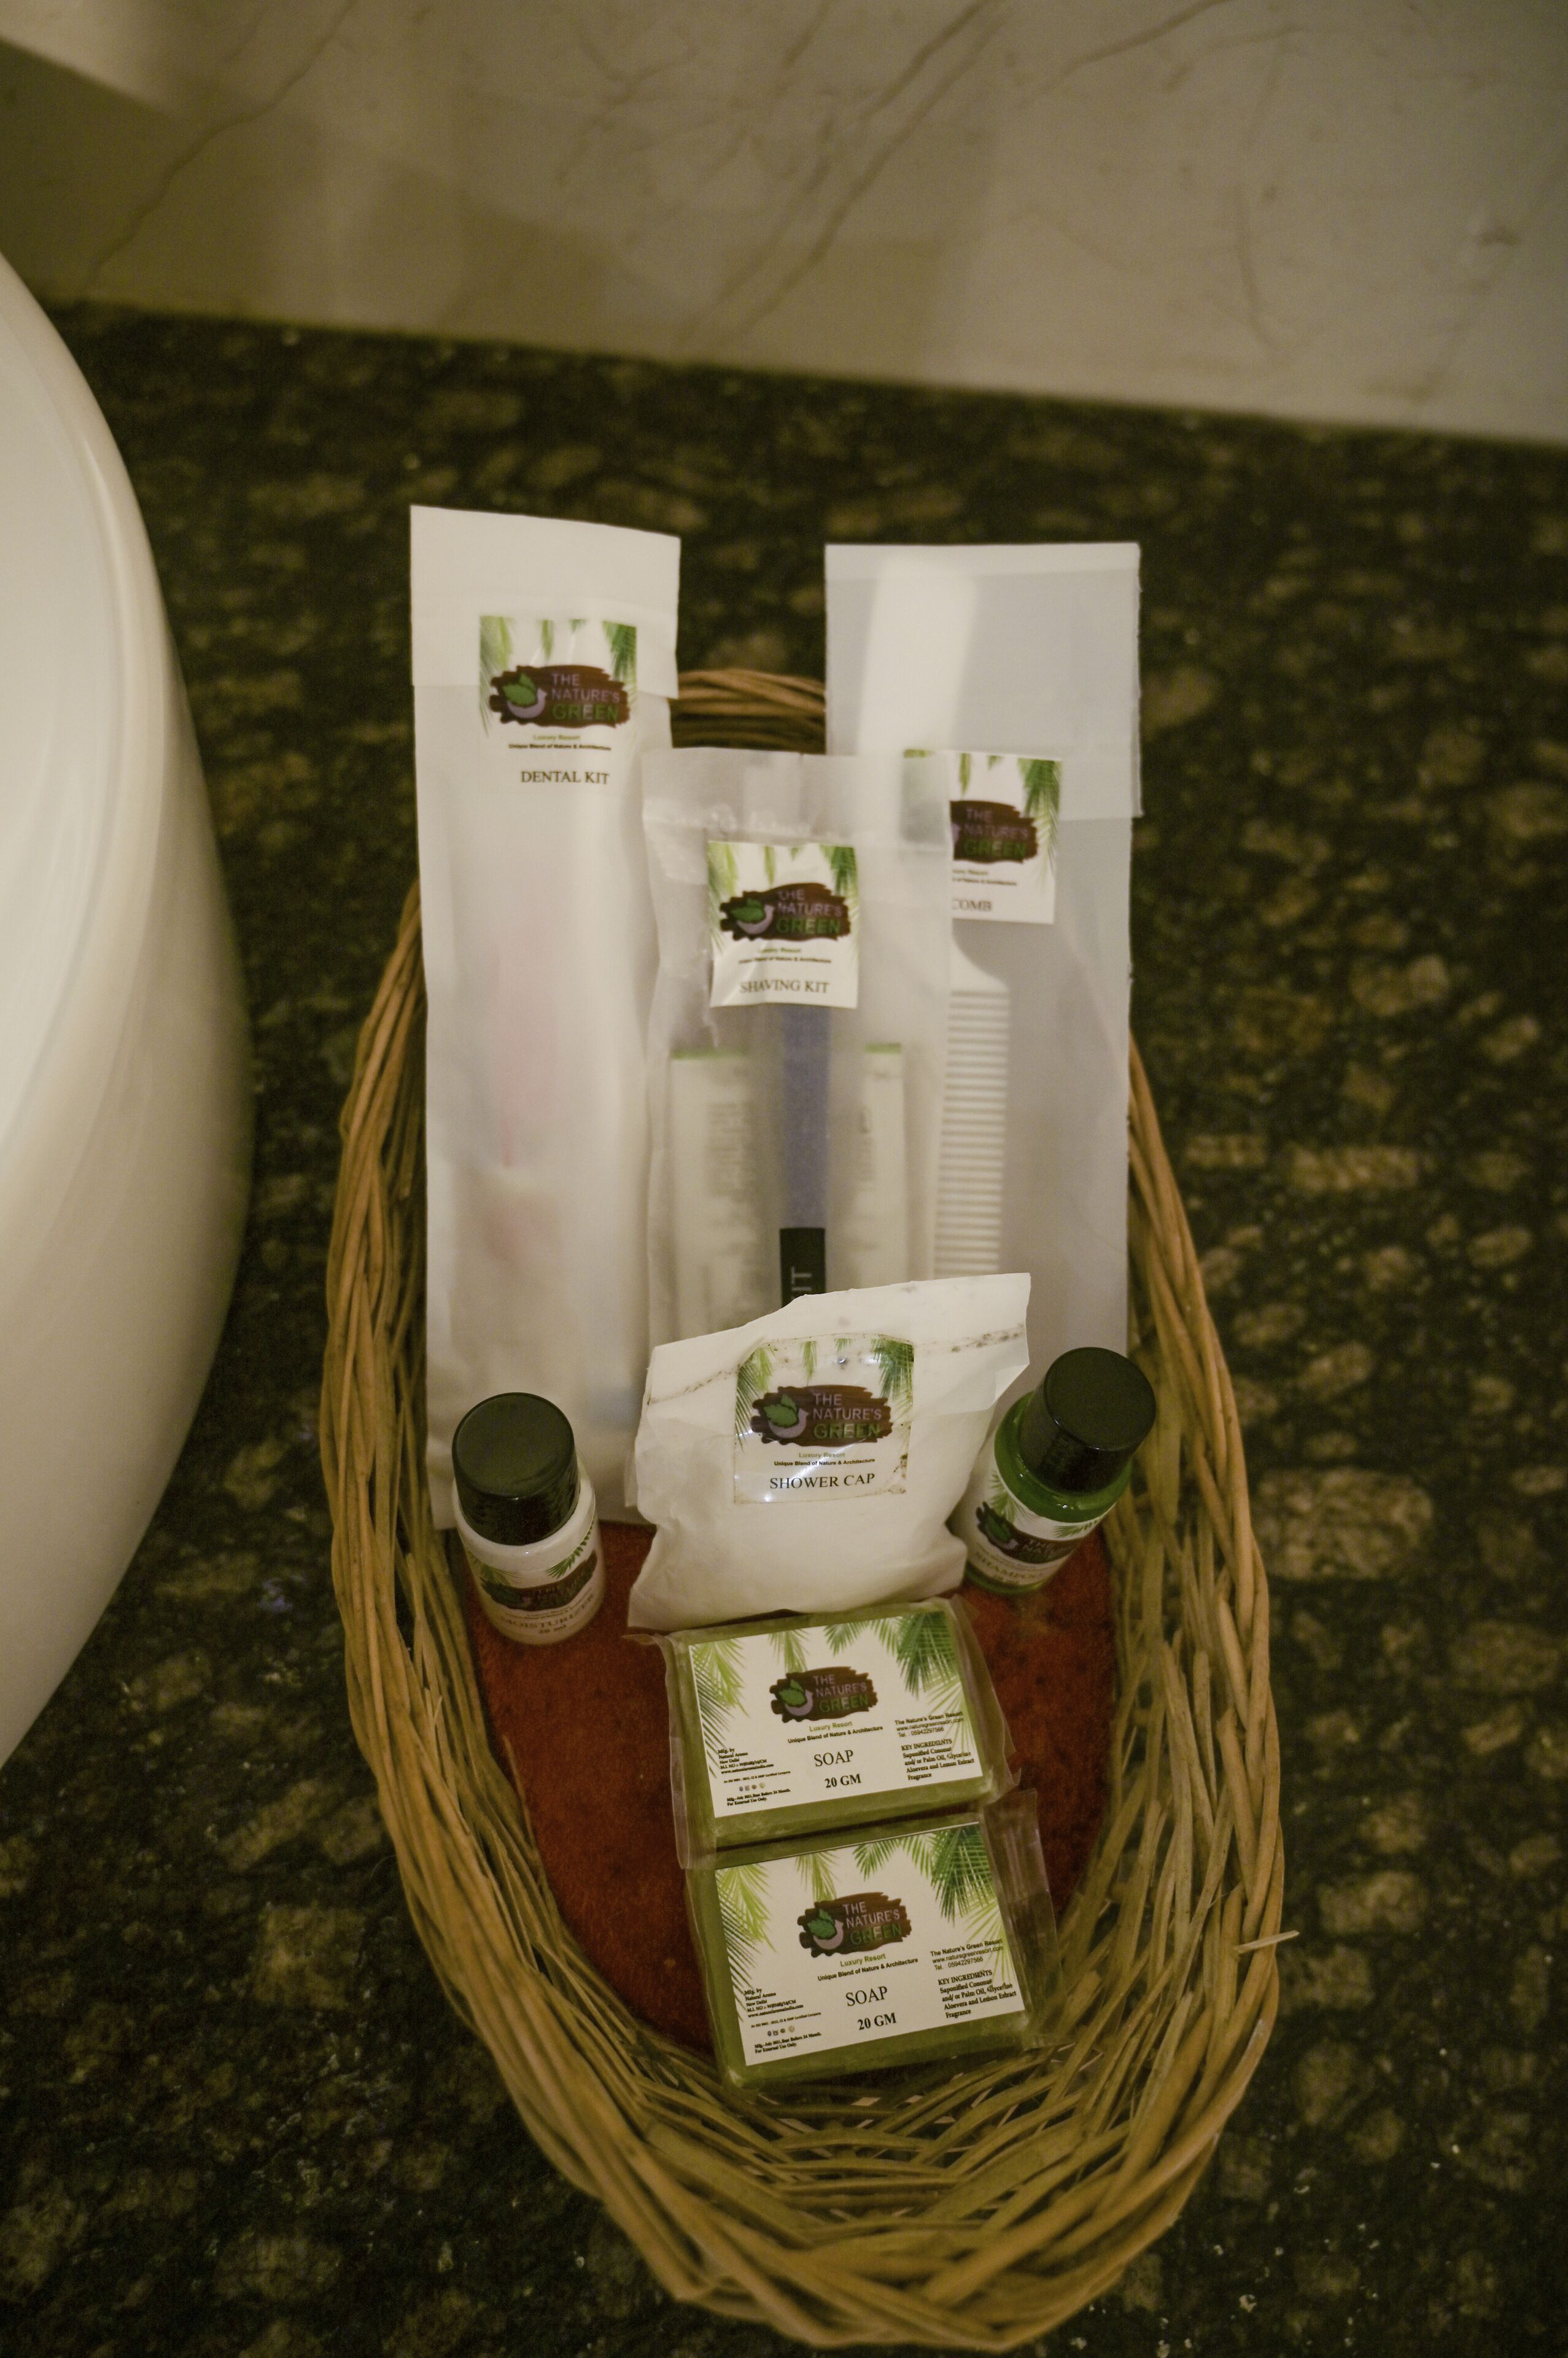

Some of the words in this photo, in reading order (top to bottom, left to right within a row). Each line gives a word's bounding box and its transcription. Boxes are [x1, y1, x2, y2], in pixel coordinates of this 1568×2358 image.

[553, 674, 580, 687] THE
[553, 688, 620, 703] NATURE'S
[553, 704, 619, 720] GREEN
[521, 771, 581, 783] DENTAL
[585, 772, 610, 784] KIT
[966, 808, 993, 822] THE
[963, 839, 1027, 857] GREEN
[779, 890, 805, 901] THE
[777, 903, 842, 917] NATURE'S
[776, 919, 841, 934] GREEN
[740, 980, 800, 994] SHAVING
[805, 982, 829, 994] KIT
[813, 1393, 842, 1406] THE
[813, 1408, 882, 1420] NATURE'S
[813, 1423, 881, 1439] GREEN
[770, 1476, 839, 1490] SHOWER
[844, 1473, 875, 1485] CAP
[813, 1673, 836, 1685] THE
[815, 1682, 867, 1697] NATURE'S
[818, 1694, 869, 1711] GREEN
[914, 1739, 952, 1748] INGREDIENTS
[813, 1750, 854, 1765] SOAP
[825, 1778, 837, 1787] 20
[839, 1774, 861, 1785] GM
[842, 1901, 867, 1915] THE
[845, 1909, 900, 1927] NATURE'S
[849, 1923, 902, 1944] GREEN
[840, 1958, 863, 1967] Luxury
[864, 1953, 886, 1962] Resort
[885, 1958, 918, 1967] Architecture
[950, 1970, 992, 1982] INGREDIENTS
[939, 1983, 968, 1993] Saponified
[845, 1986, 889, 2005] SOAP
[945, 2009, 972, 2018] Fragrance
[857, 2018, 871, 2029] 20
[873, 2013, 896, 2026] GM
